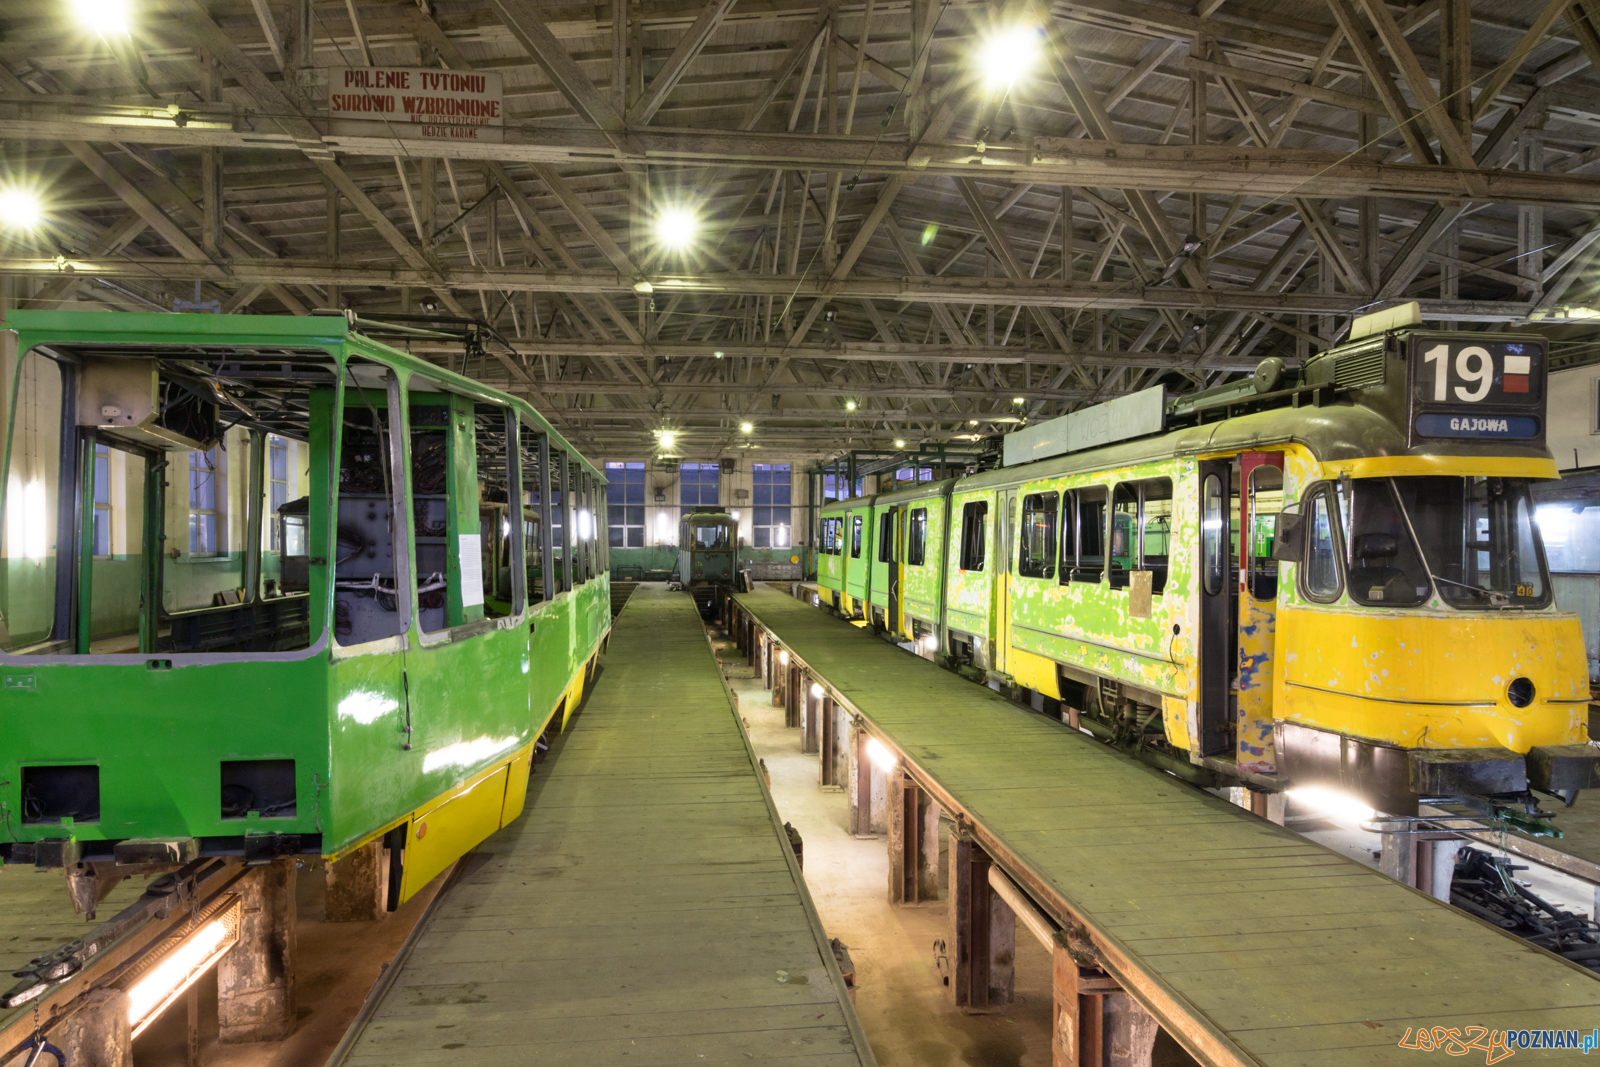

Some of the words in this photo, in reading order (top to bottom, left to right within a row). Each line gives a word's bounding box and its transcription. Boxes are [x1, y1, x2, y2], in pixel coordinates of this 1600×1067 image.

[344, 70, 410, 89] PALENIE
[420, 72, 486, 93] TYTONIU
[332, 94, 395, 112] SUROWO
[402, 96, 500, 118] WZBRONIONE
[1424, 344, 1494, 402] 19
[1450, 418, 1508, 432] GAJOWA
